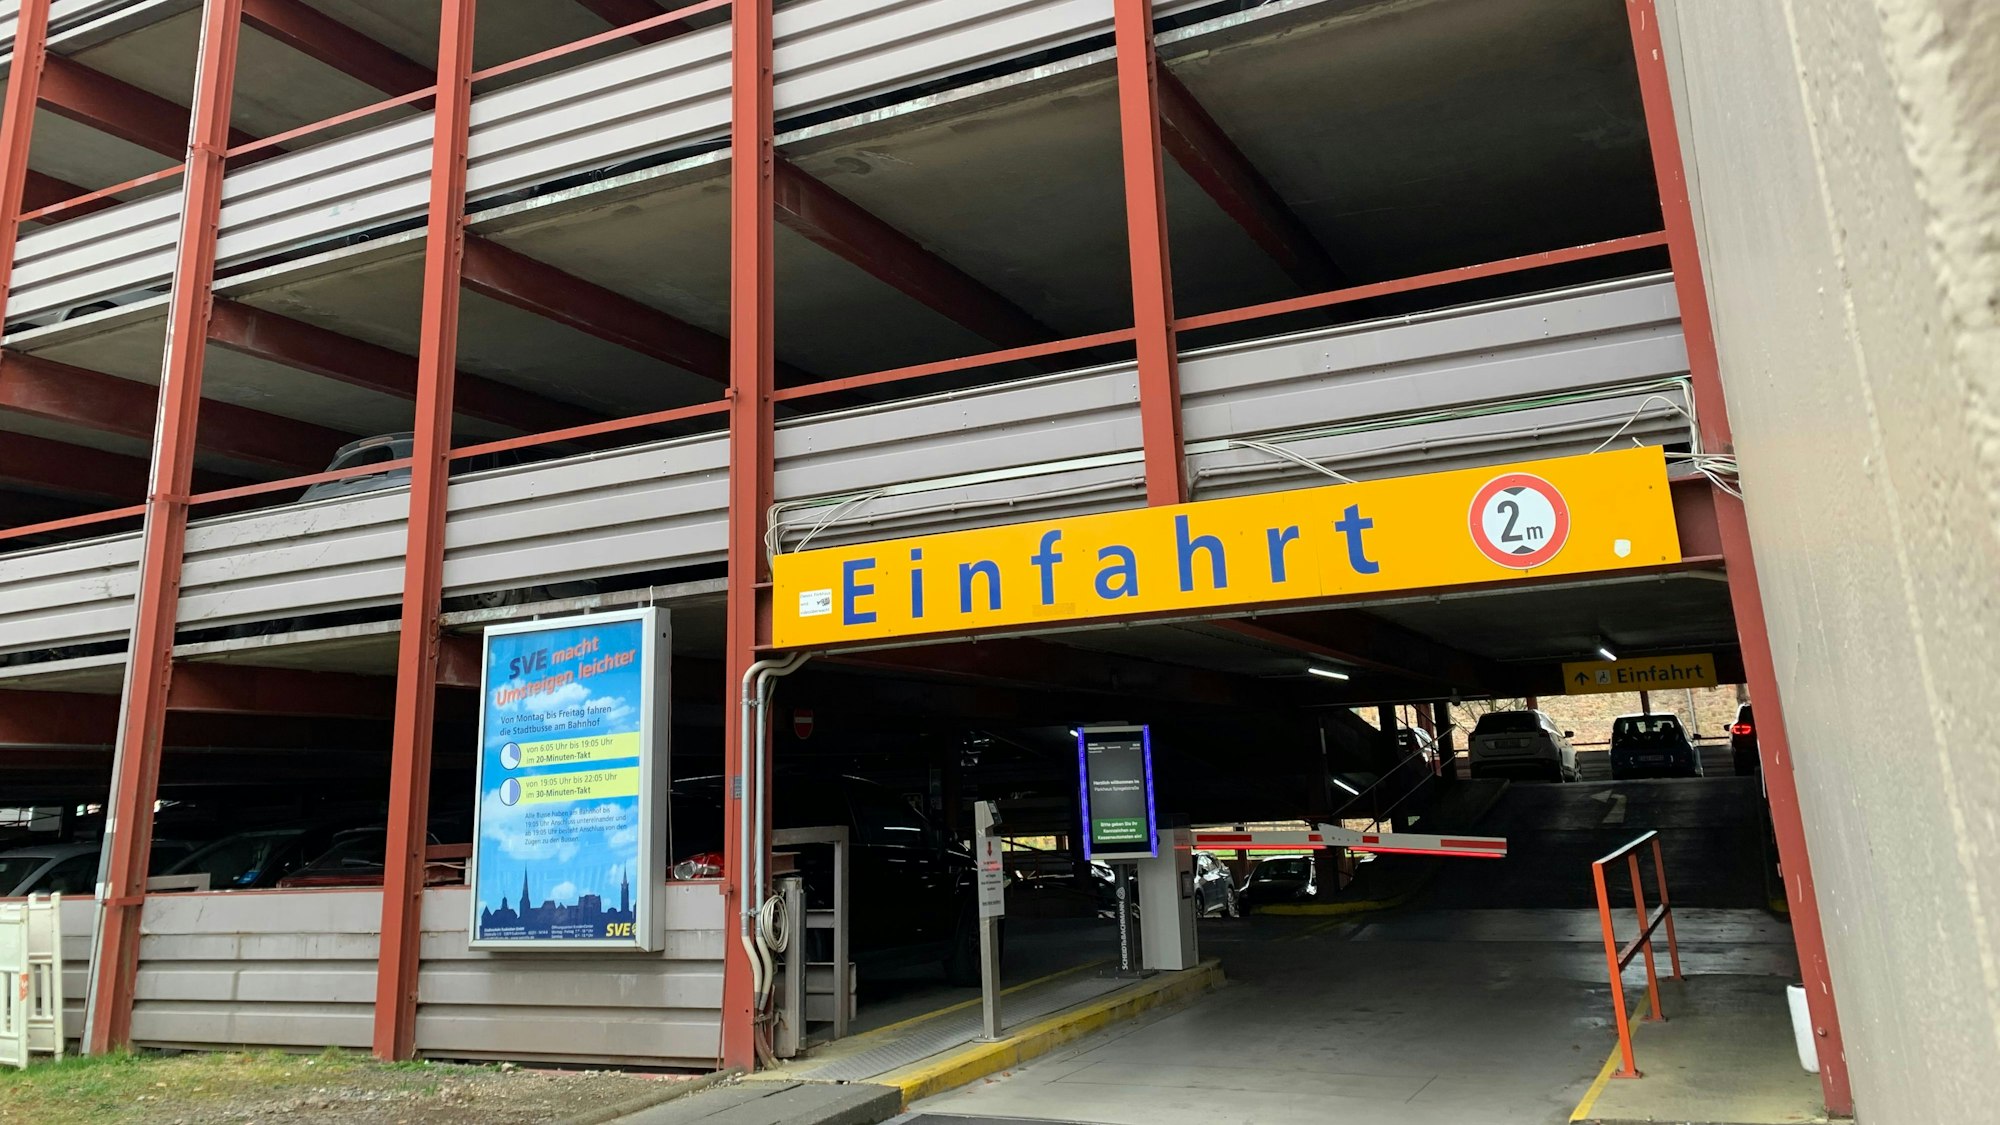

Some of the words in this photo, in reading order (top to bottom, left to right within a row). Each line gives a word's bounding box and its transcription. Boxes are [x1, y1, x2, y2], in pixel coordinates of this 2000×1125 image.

[842, 503, 1381, 626] Einfahrt
[508, 648, 548, 680] SVE
[552, 636, 600, 664] macht
[497, 670, 574, 706] Umsteigen
[578, 650, 636, 679] leichter
[1616, 664, 1704, 684] Einfahrt
[500, 716, 514, 725] Von
[516, 712, 544, 724] Montag
[546, 710, 557, 720] bis
[558, 708, 585, 719] Freitag
[587, 705, 612, 716] fahren
[500, 727, 511, 736] die
[512, 722, 552, 736] Stadtbusse
[554, 722, 566, 731] am
[568, 718, 600, 729] Bahnhof
[526, 746, 539, 754] von
[556, 742, 568, 750] Uhr
[570, 740, 580, 749] bis
[582, 739, 600, 748] 19:05
[601, 738, 613, 746] Uhr
[536, 752, 591, 764] 20-Minuten-Takt
[526, 780, 538, 788] von
[540, 778, 558, 787] 19:05
[560, 776, 572, 786] Uhr
[574, 775, 583, 784] bis
[584, 774, 603, 783] 22:05
[604, 772, 618, 782] Uhr
[526, 790, 534, 798] im
[536, 786, 591, 798] 30-Minuten-Takt
[552, 808, 569, 817] haben
[579, 807, 602, 816] Bahnhof
[540, 818, 550, 827] Uhr
[616, 814, 627, 822] und
[548, 826, 558, 835] Uhr
[616, 822, 628, 830] den
[606, 922, 631, 937] SVE
